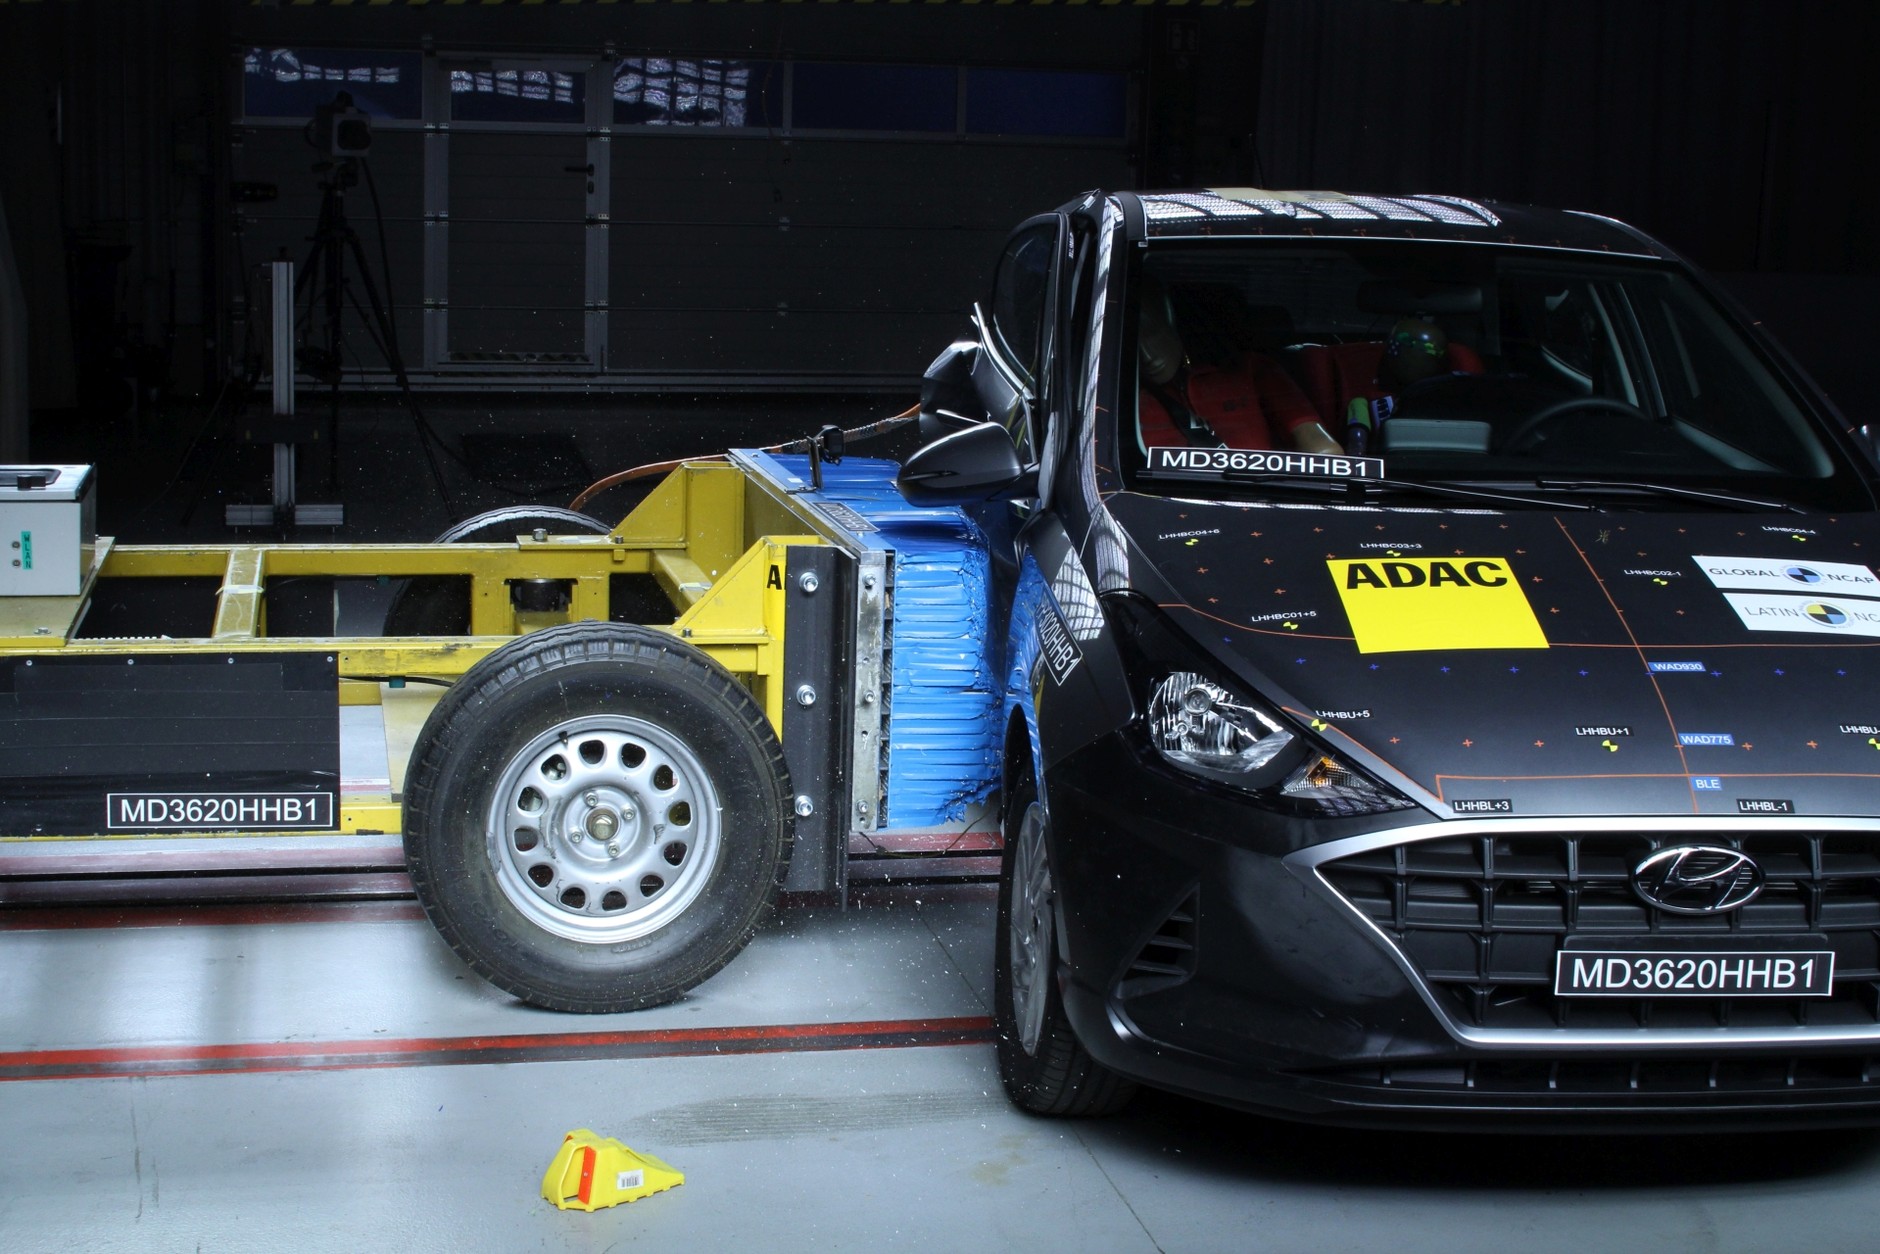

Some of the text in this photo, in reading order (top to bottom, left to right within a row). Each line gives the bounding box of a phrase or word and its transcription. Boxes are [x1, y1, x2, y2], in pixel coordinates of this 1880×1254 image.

[1162, 451, 1367, 477] MD3620HHB1
[1158, 529, 1220, 540] LHHBC04+6
[23, 533, 32, 569] WLAN
[1346, 561, 1508, 590] ADAC
[1708, 567, 1780, 578] GLOBAL
[1827, 573, 1875, 584] NCAP
[1251, 611, 1317, 622] LHHBC01+5
[1744, 607, 1800, 618] LATIN
[1654, 663, 1704, 671] WAD930
[1315, 709, 1371, 719] LHHBU+5
[1575, 727, 1630, 736] LHHBU+1
[1681, 735, 1732, 745] WAD775
[1695, 779, 1721, 790] BLE
[121, 797, 317, 823] MD3620HHB1
[1454, 800, 1510, 812] LHHBL+3
[1739, 801, 1789, 811] LHHBL-1
[1572, 958, 1815, 989] MD3620HHB1
